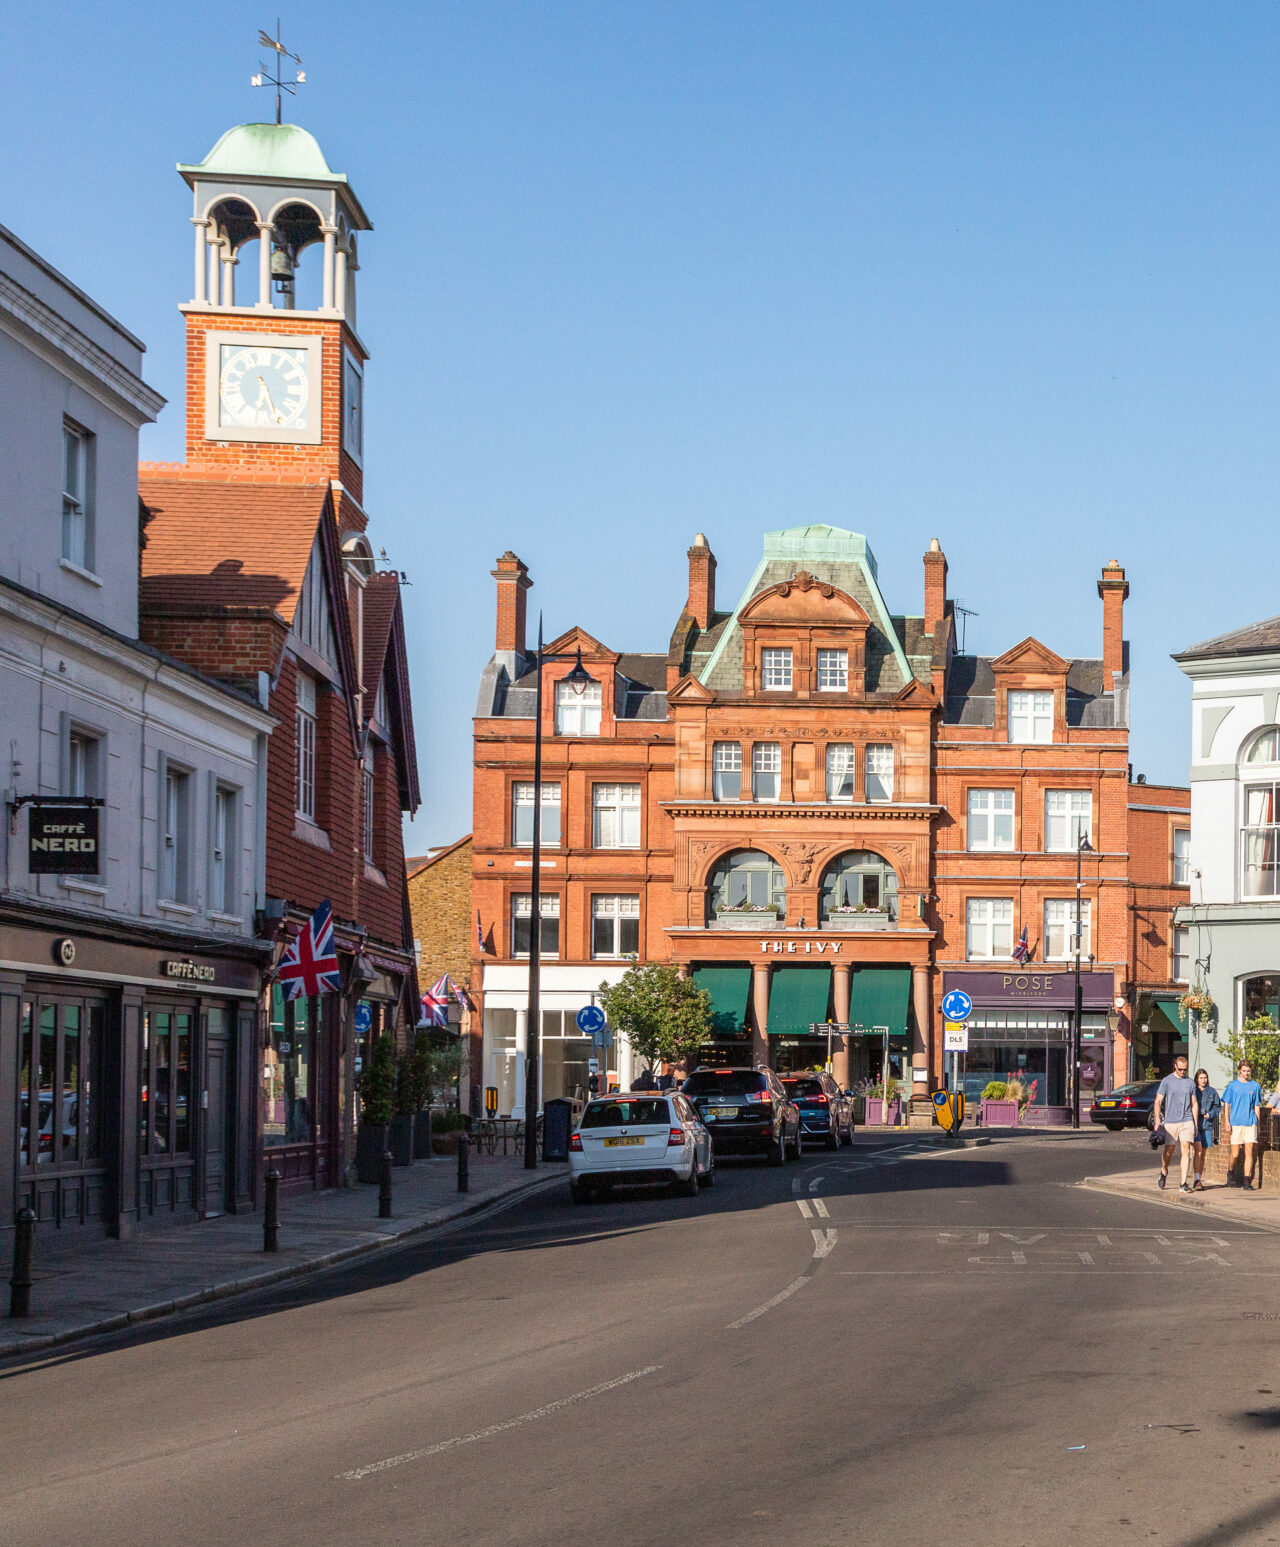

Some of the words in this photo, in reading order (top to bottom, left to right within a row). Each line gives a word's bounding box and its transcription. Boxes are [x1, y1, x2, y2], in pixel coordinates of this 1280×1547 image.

[42, 822, 86, 834] CAFFÈ
[31, 837, 96, 852] NERO
[760, 941, 796, 953] THE
[805, 941, 843, 953] IVY
[1003, 976, 1053, 990] POSE
[967, 1250, 1233, 1267] KEEP
